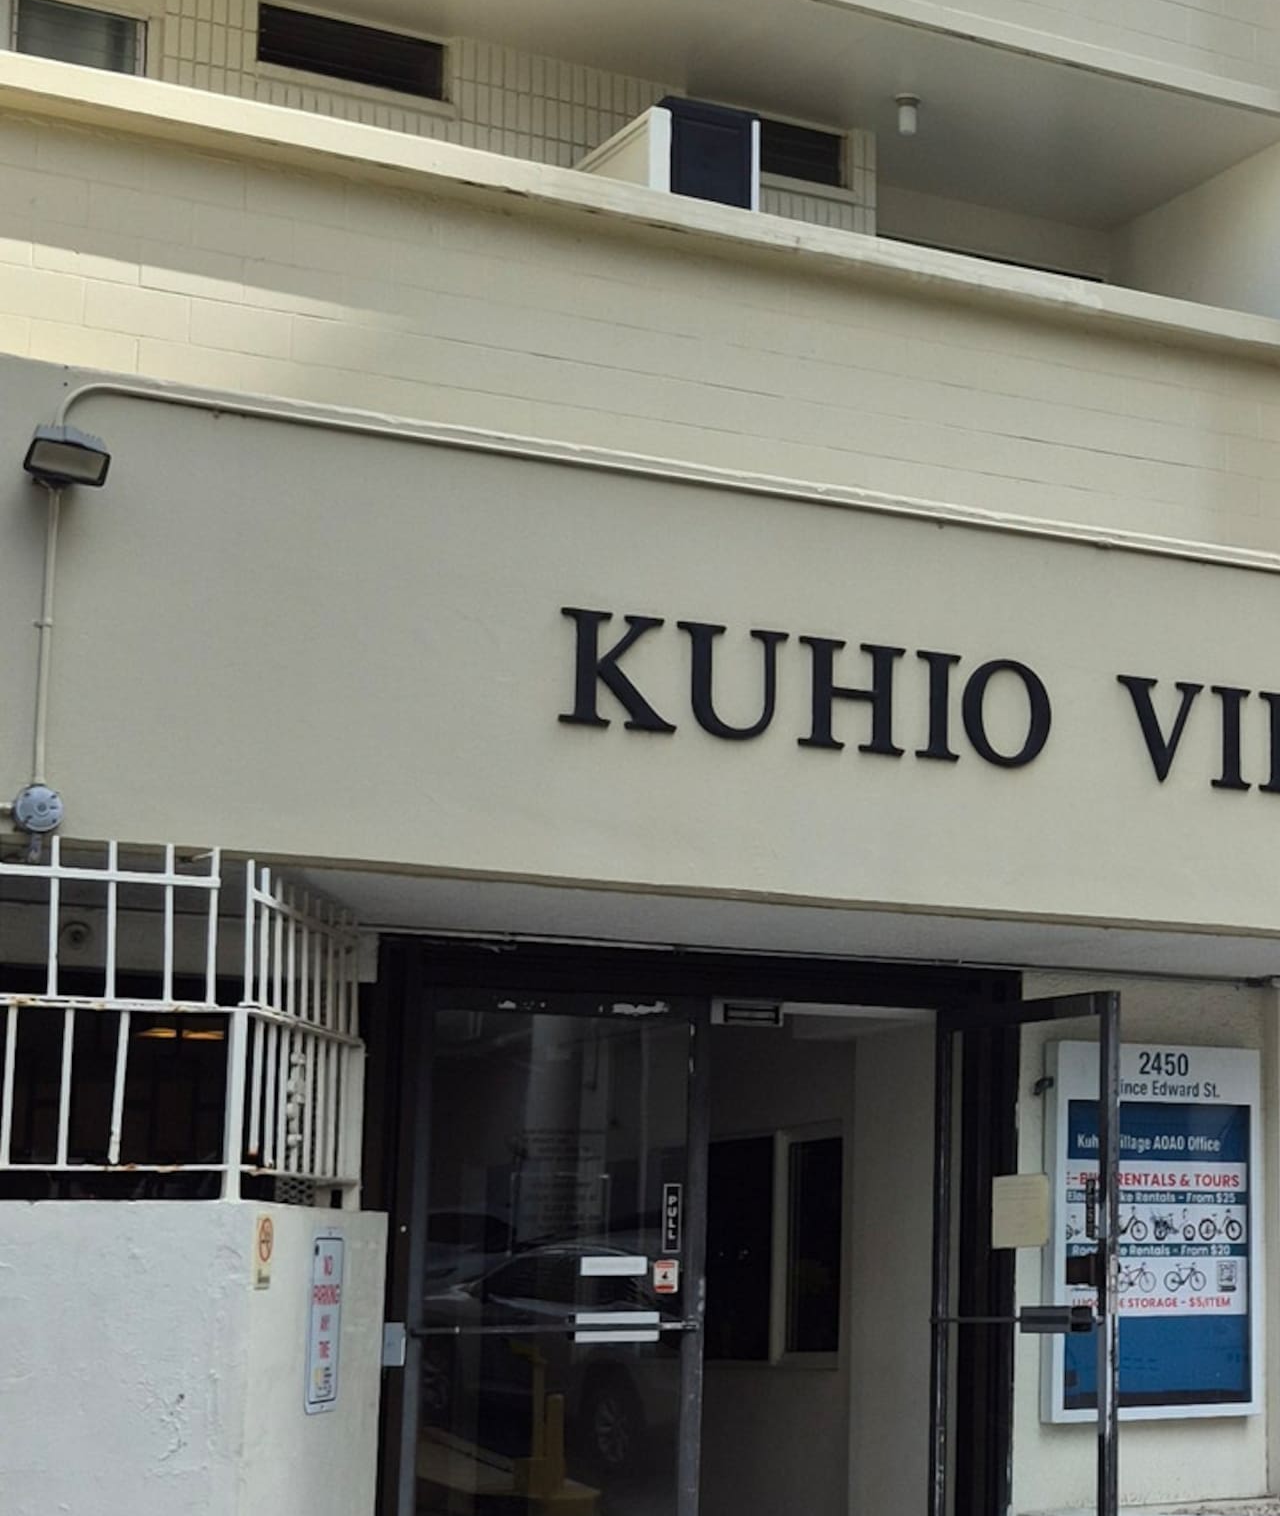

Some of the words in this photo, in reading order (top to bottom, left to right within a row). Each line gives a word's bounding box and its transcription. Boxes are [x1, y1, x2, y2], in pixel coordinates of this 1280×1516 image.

[557, 606, 1052, 768] KUHIO
[1138, 1051, 1189, 1077] 2450
[1119, 1078, 1148, 1096] ince
[1152, 1080, 1200, 1097] Edward
[1203, 1081, 1220, 1098] St.
[1076, 1133, 1100, 1148] Kuh
[1119, 1134, 1150, 1153] illage
[1187, 1136, 1221, 1152] Office
[1115, 1172, 1177, 1186] RENTALS
[1180, 1174, 1190, 1187] &
[1194, 1174, 1240, 1188] TOURS
[1185, 1192, 1215, 1203] From
[1216, 1192, 1236, 1204] $25
[666, 1195, 678, 1241] PULL
[1128, 1244, 1170, 1256] Rentals
[1180, 1244, 1209, 1256] From
[1210, 1244, 1232, 1256] $20
[1127, 1297, 1177, 1308] STORAGE
